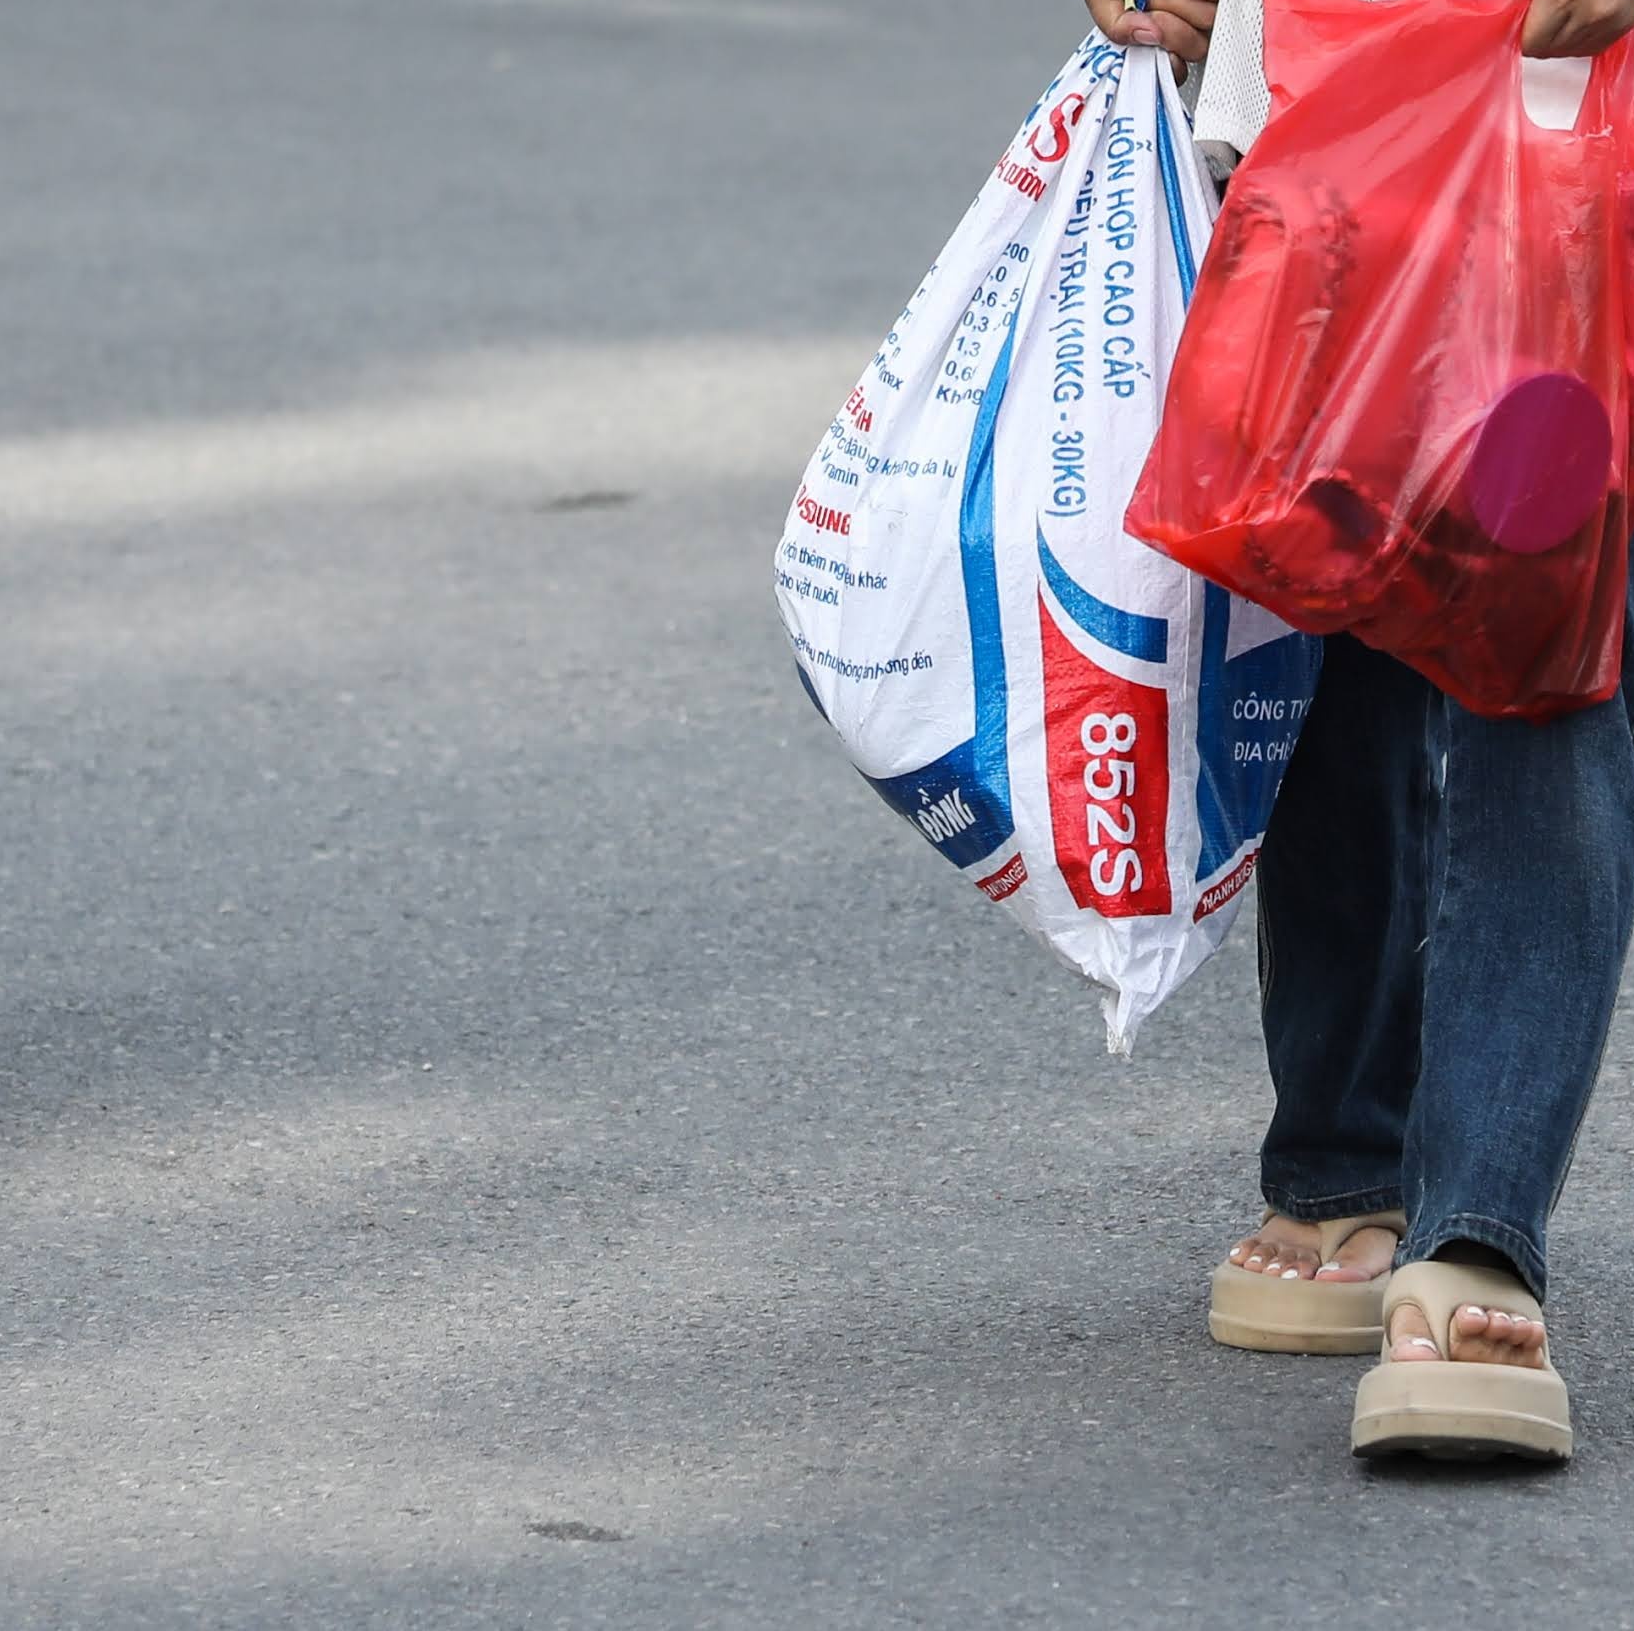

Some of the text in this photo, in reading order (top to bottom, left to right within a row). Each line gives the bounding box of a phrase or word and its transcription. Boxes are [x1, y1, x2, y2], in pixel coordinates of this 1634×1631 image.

[1050, 241, 1088, 312] TRẠI
[1098, 117, 1153, 399] HỖN HỢP CAO CẤP
[956, 336, 981, 357] 1,3
[1049, 318, 1086, 402] (10KG
[1045, 430, 1087, 519] 30KG)
[858, 571, 888, 590] khác
[1233, 691, 1285, 721] CÔNG
[1234, 741, 1263, 768] ĐỊA
[1080, 712, 1143, 897] 852S
